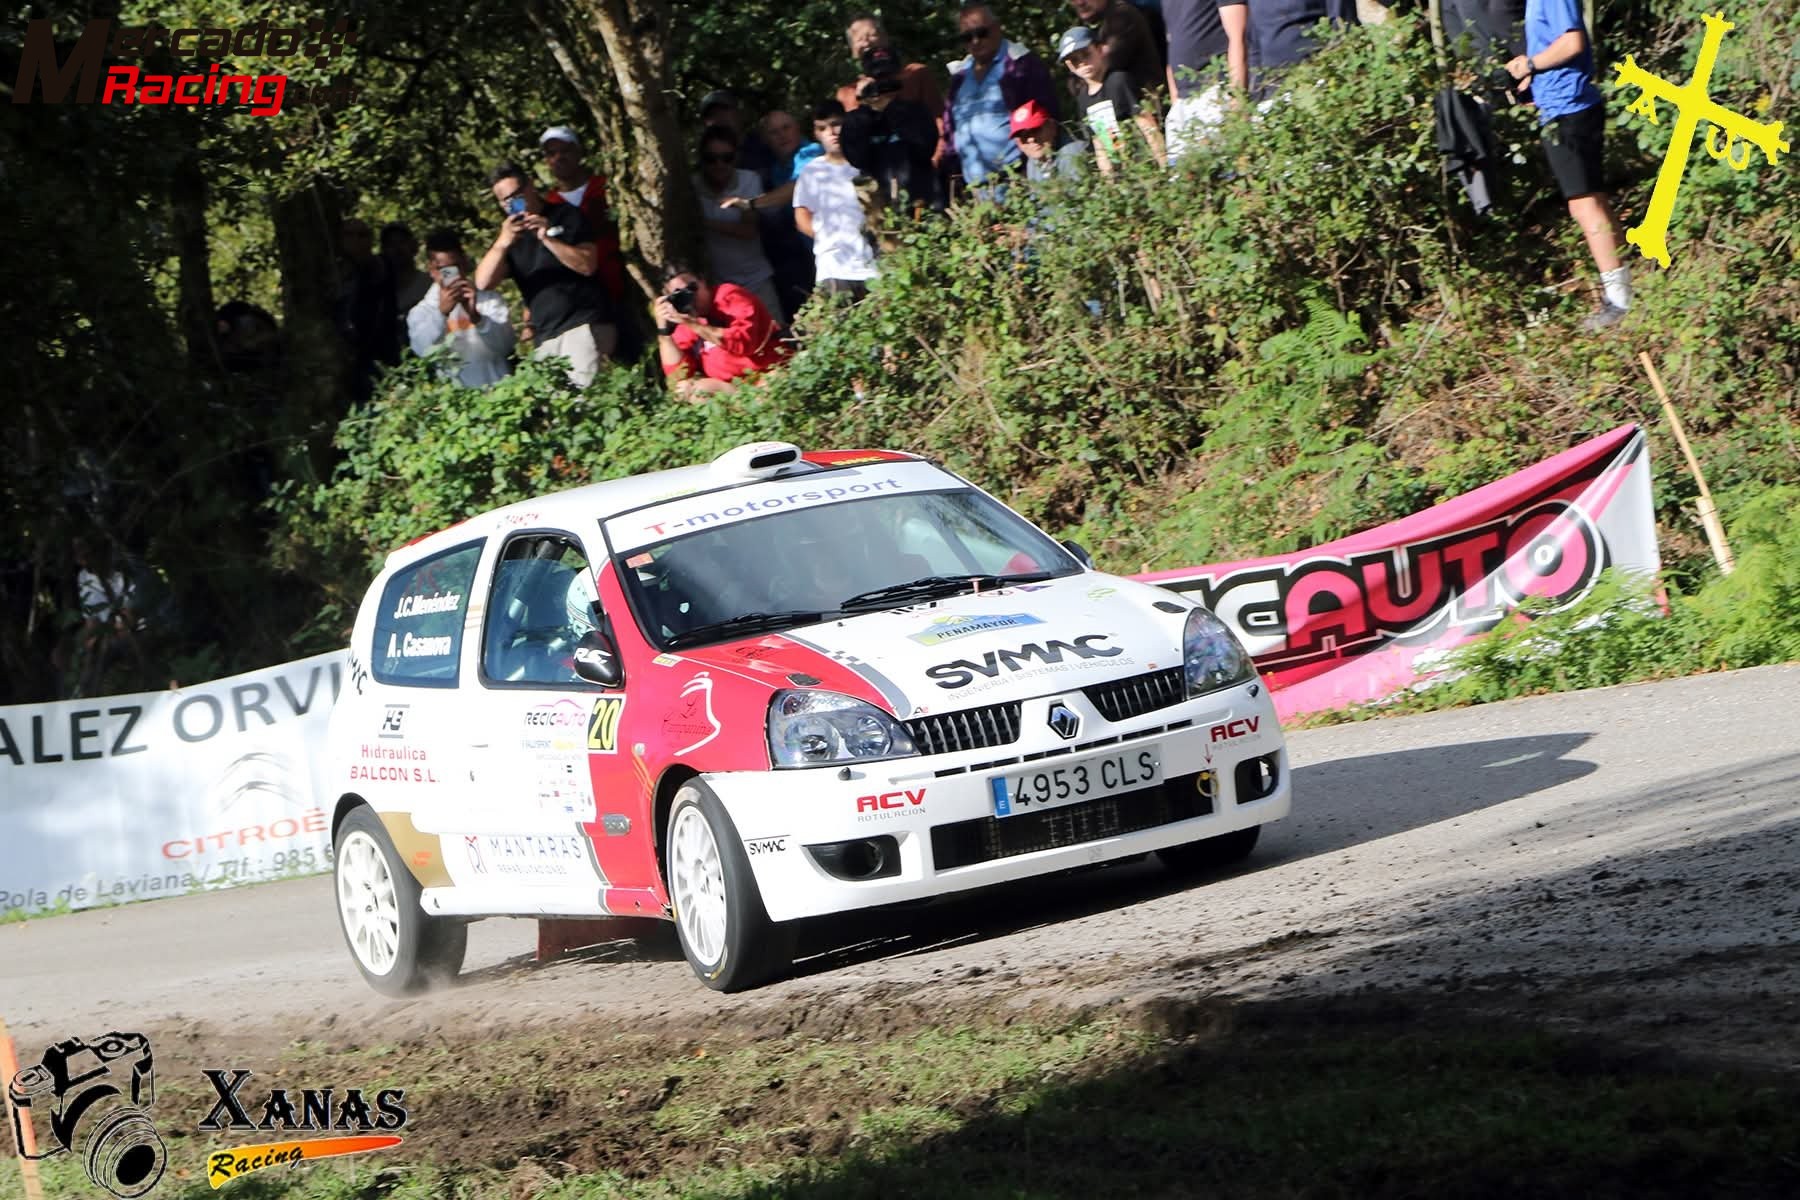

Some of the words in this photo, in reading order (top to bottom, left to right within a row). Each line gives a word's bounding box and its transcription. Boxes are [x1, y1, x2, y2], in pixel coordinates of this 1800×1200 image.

[644, 477, 902, 536] T-motorsport
[402, 632, 452, 658] Casanova
[925, 634, 1125, 690] SVMAC
[588, 698, 621, 751] 20
[1210, 715, 1260, 742] ACV
[361, 744, 427, 760] Hidraulica
[350, 766, 408, 781] BALCON
[1015, 766, 1091, 807] 4953
[1101, 751, 1155, 789] CLS
[856, 788, 927, 812] ACV
[489, 836, 582, 859] MANTARAS
[749, 839, 787, 855] SVMAC
[58, 883, 88, 903] de
[96, 871, 194, 898] Laviana
[273, 847, 316, 873] 985
